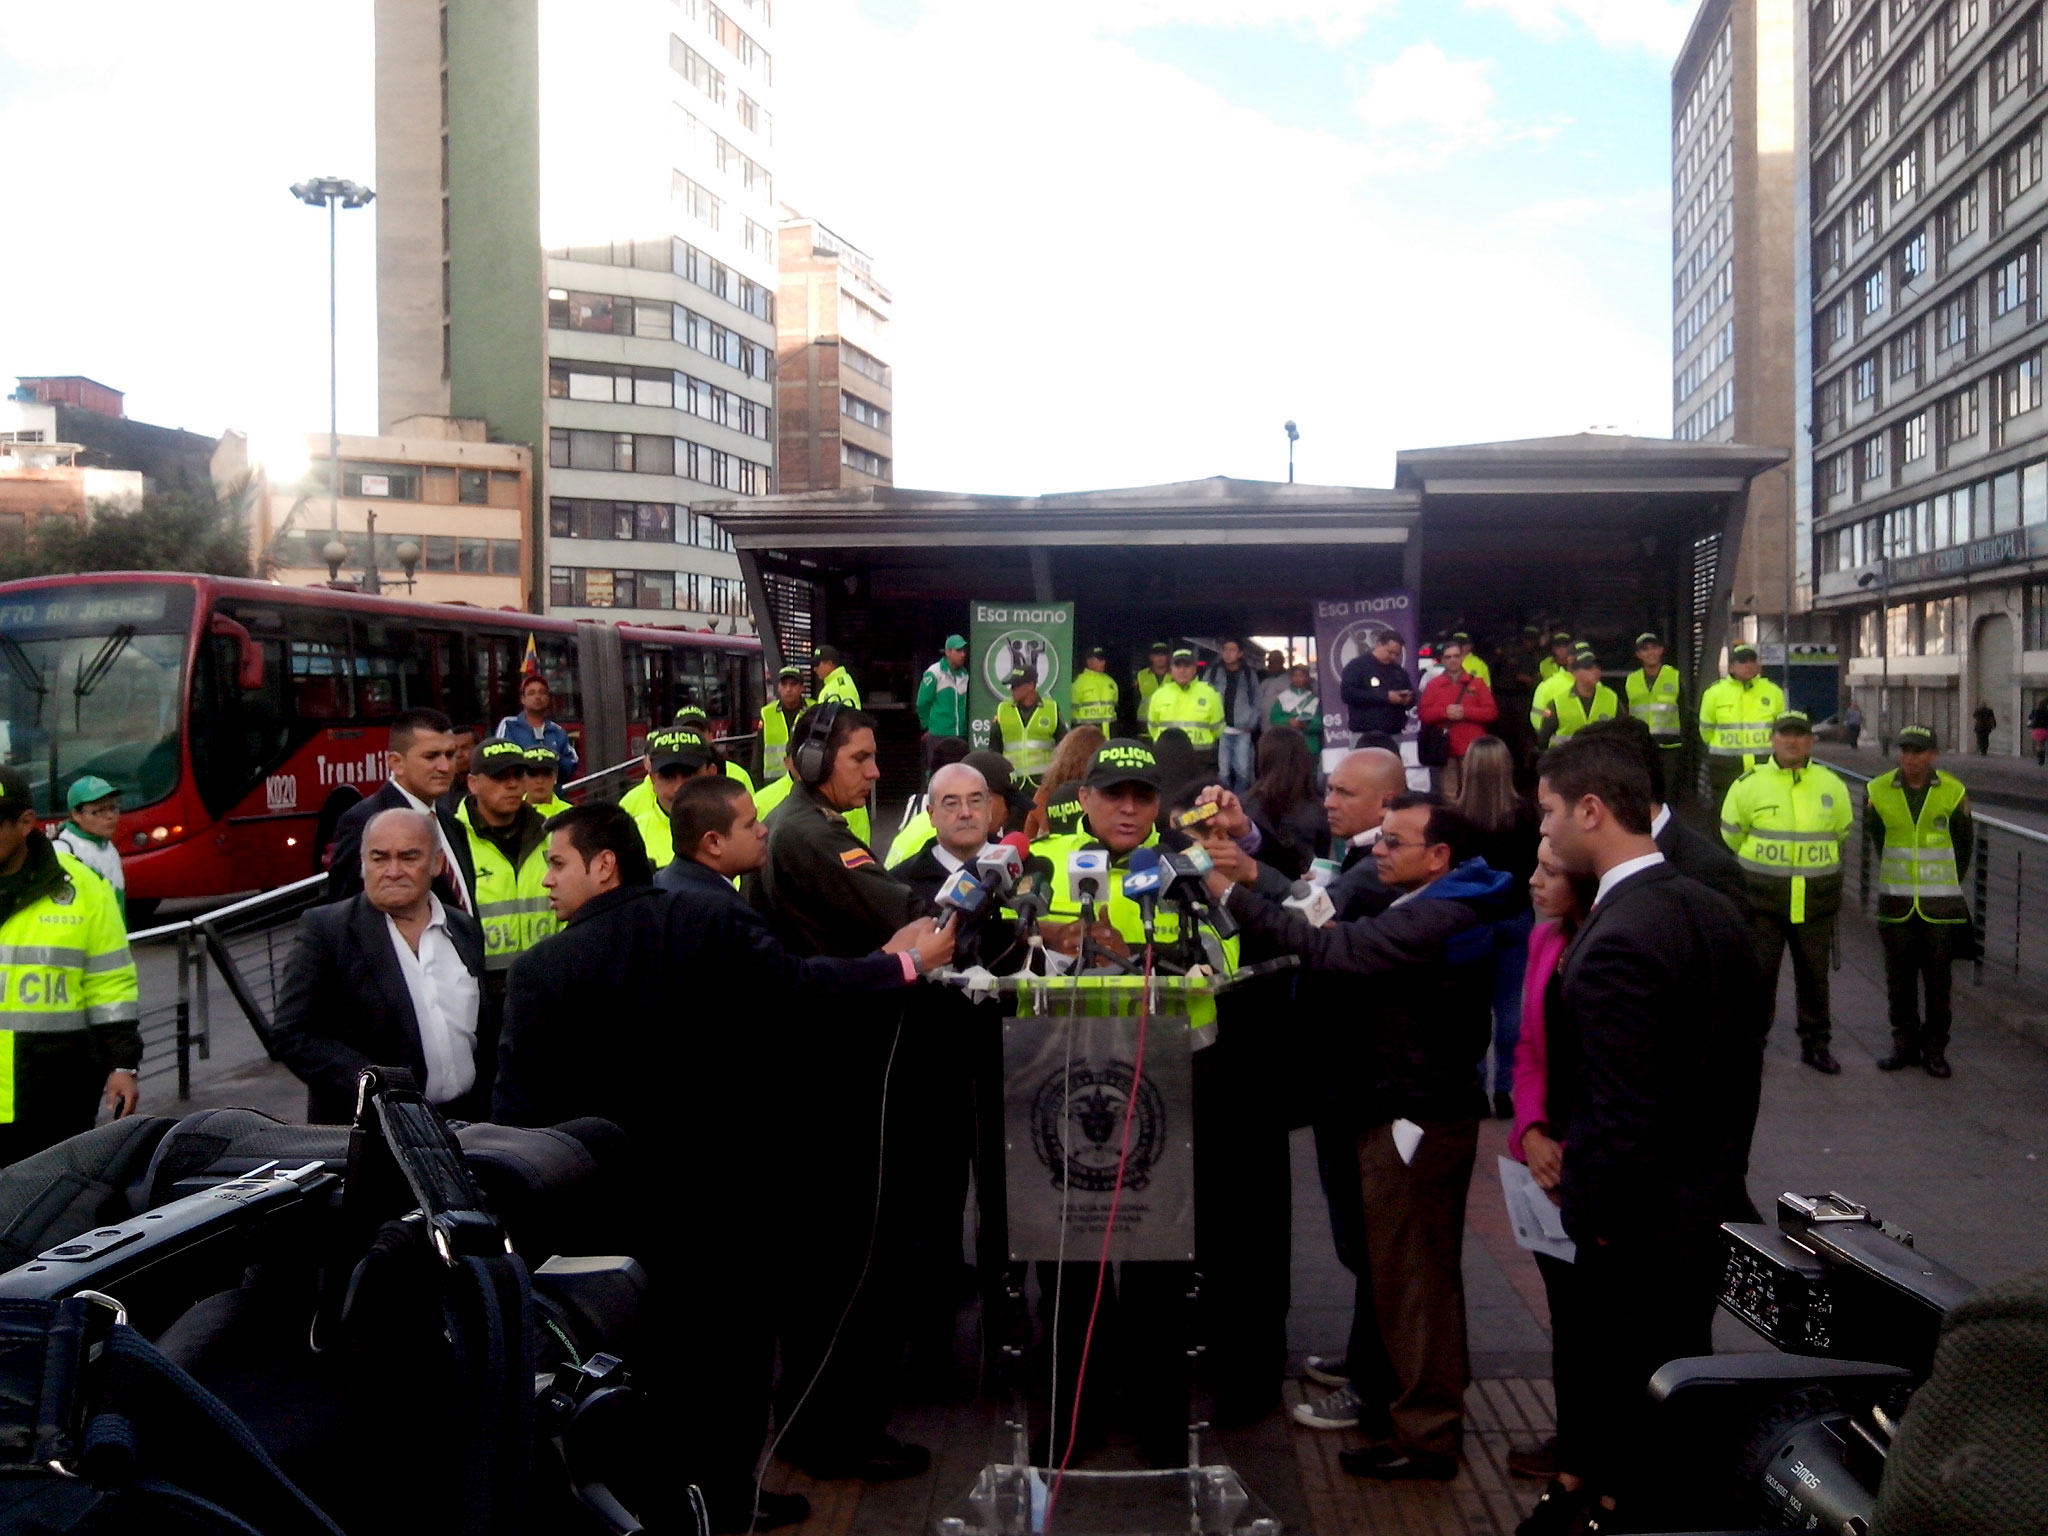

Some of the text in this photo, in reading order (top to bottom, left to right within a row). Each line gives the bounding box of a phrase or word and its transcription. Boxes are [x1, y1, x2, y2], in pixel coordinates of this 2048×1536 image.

[977, 606, 1067, 624] Esa mano
[1318, 595, 1409, 618] Esa mano
[677, 705, 707, 718] POLICIA
[654, 732, 701, 748] POLICIA
[1098, 746, 1157, 765] POLICIA
[1048, 799, 1083, 819] POLICIA
[1755, 844, 1833, 864] POLICIA
[1790, 1460, 1821, 1490] 3MOS
[1789, 1495, 1802, 1513] FOCUS
